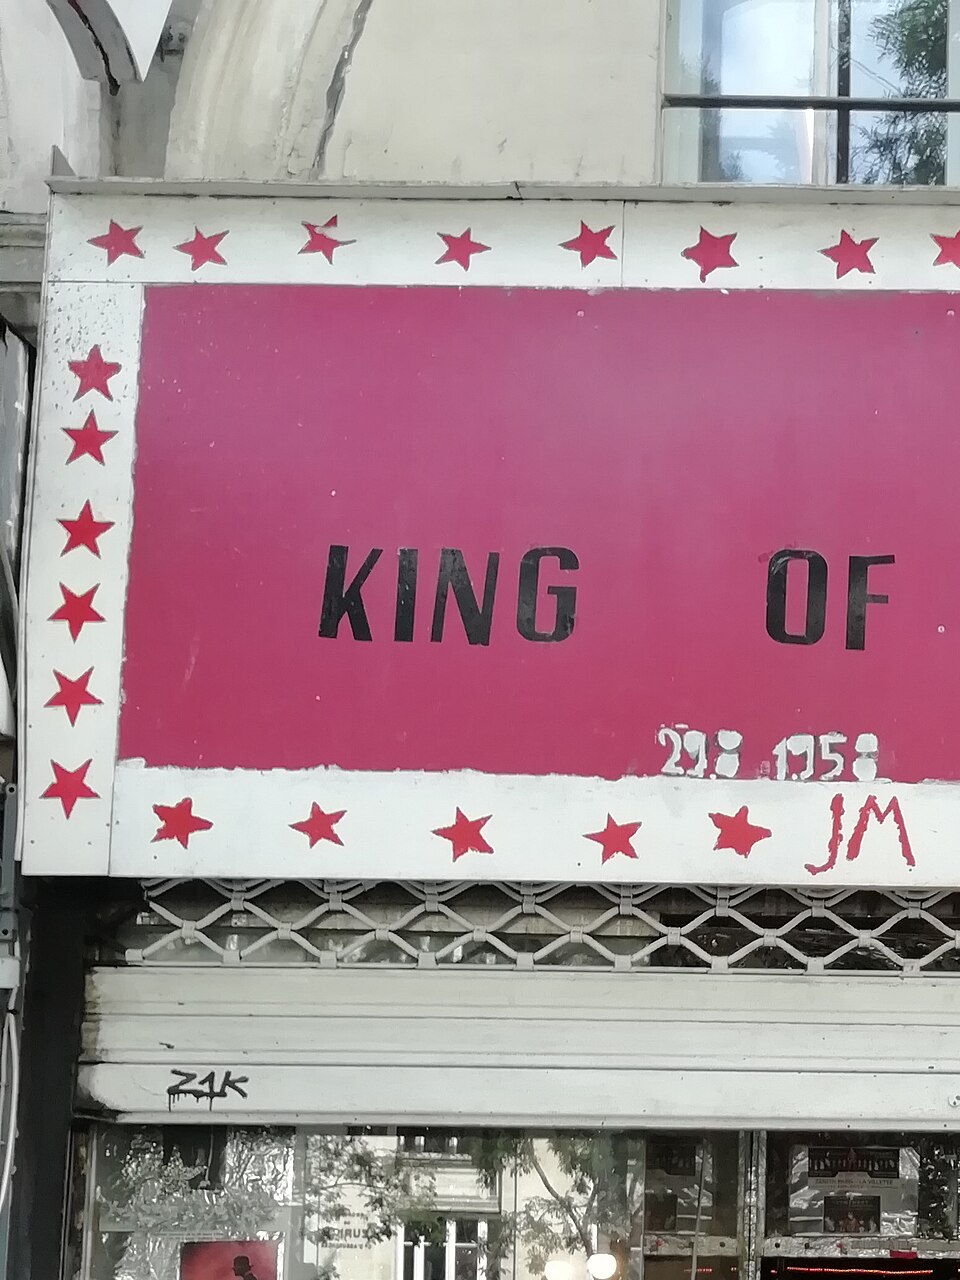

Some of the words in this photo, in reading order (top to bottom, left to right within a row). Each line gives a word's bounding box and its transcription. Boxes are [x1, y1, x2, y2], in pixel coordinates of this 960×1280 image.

[318, 544, 580, 646] KING
[766, 549, 896, 651] OF
[804, 793, 915, 875] JM
